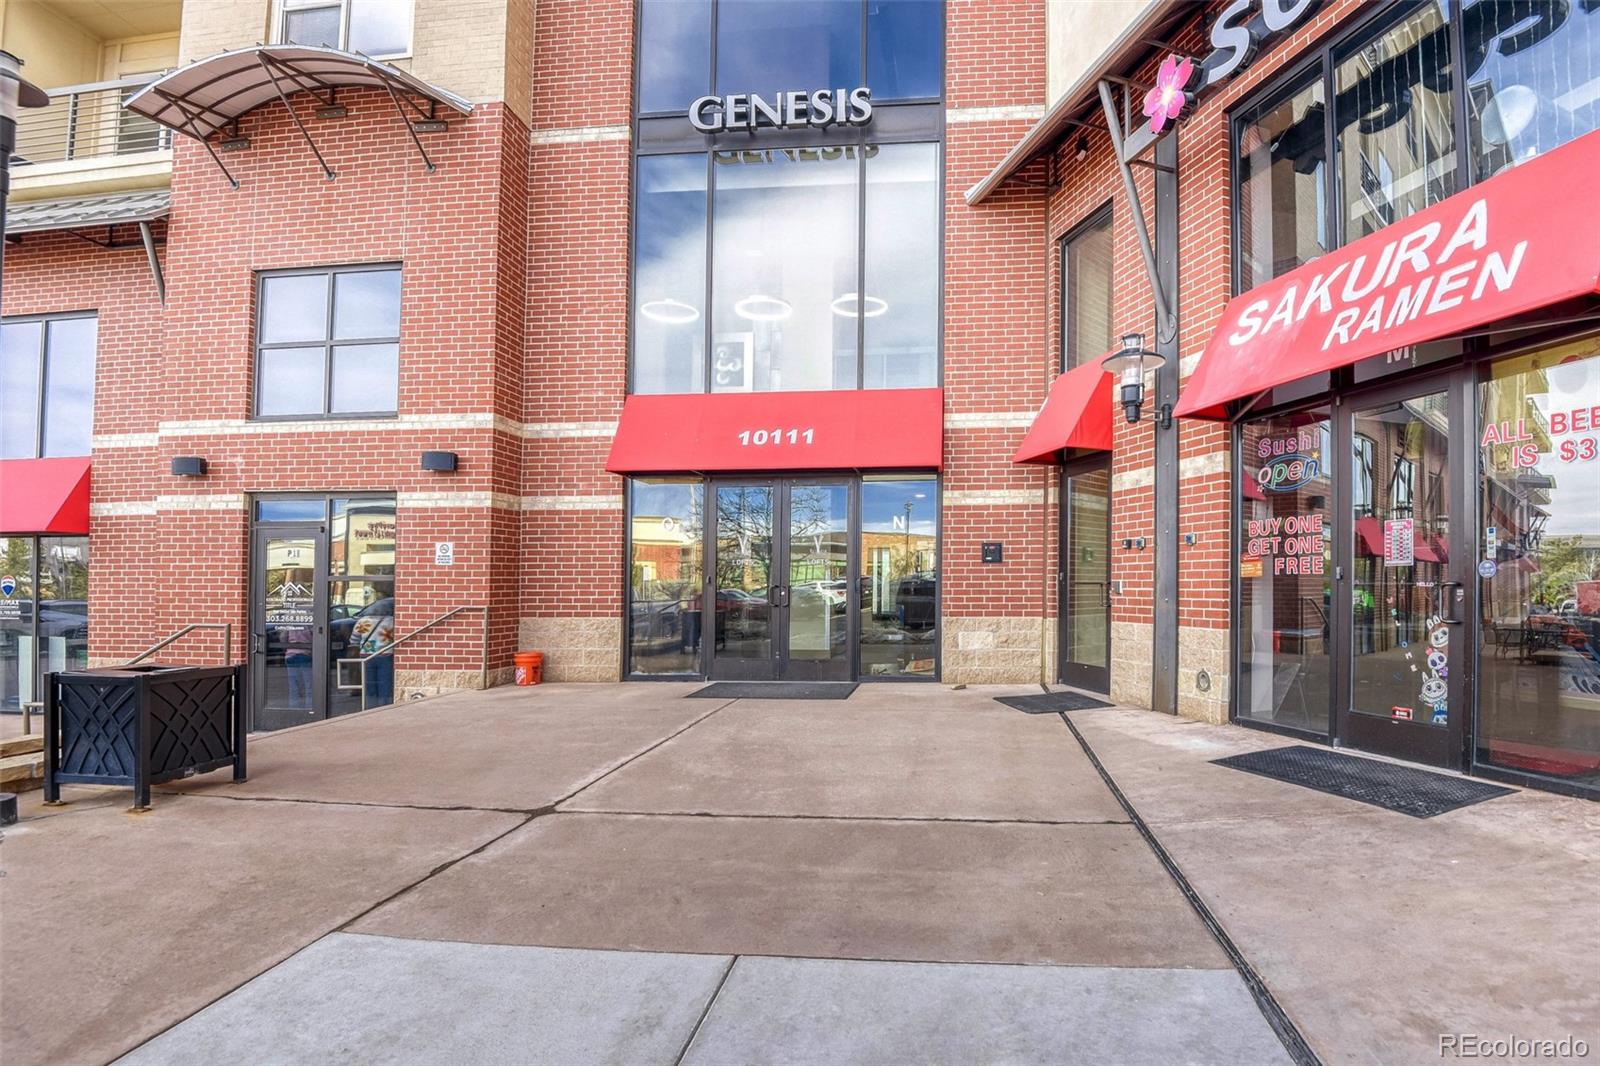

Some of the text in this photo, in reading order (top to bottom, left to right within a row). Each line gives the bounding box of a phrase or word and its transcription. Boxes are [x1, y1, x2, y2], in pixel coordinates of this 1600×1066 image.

[688, 87, 873, 133] GENESIS
[1228, 198, 1488, 346] SAKURA
[1322, 241, 1529, 351] RAMEN
[738, 428, 815, 446] 10111
[1258, 428, 1320, 458] Sushi
[1481, 417, 1533, 447] ALL
[1511, 437, 1598, 468] IS $3
[1258, 459, 1319, 488] open
[893, 515, 905, 530] N
[1248, 514, 1323, 537] BUY ONE
[1248, 534, 1324, 556] GET ONE
[1274, 556, 1324, 575] FREE
